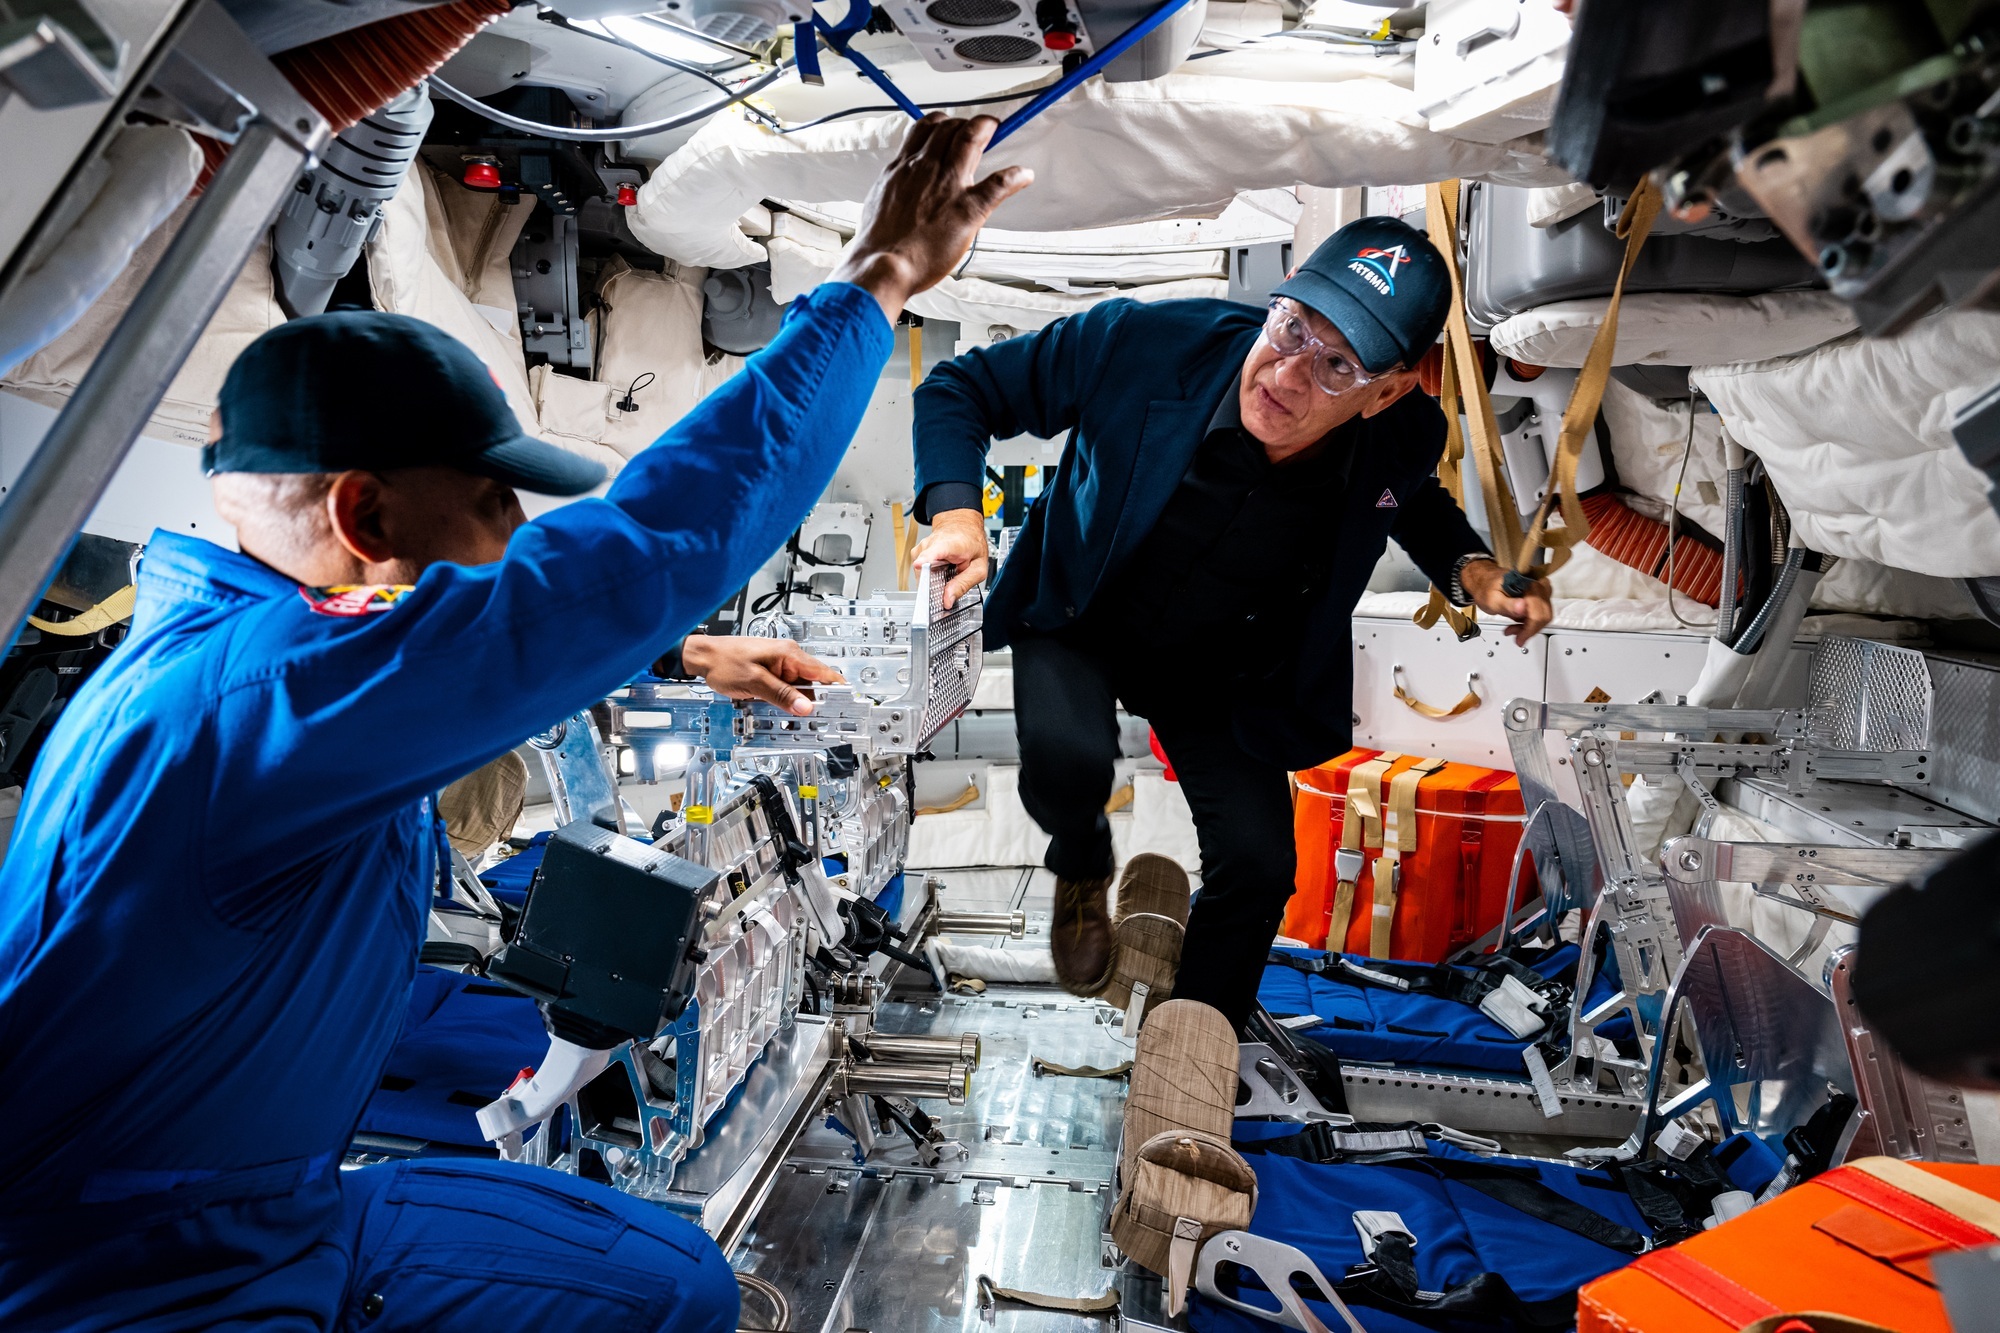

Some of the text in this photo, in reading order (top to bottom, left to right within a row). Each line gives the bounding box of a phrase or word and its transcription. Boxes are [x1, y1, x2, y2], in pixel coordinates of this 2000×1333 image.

[1347, 261, 1390, 295] ARTEMIS
[1690, 780, 1717, 810] 276-3
[895, 1103, 912, 1115] SEAT
